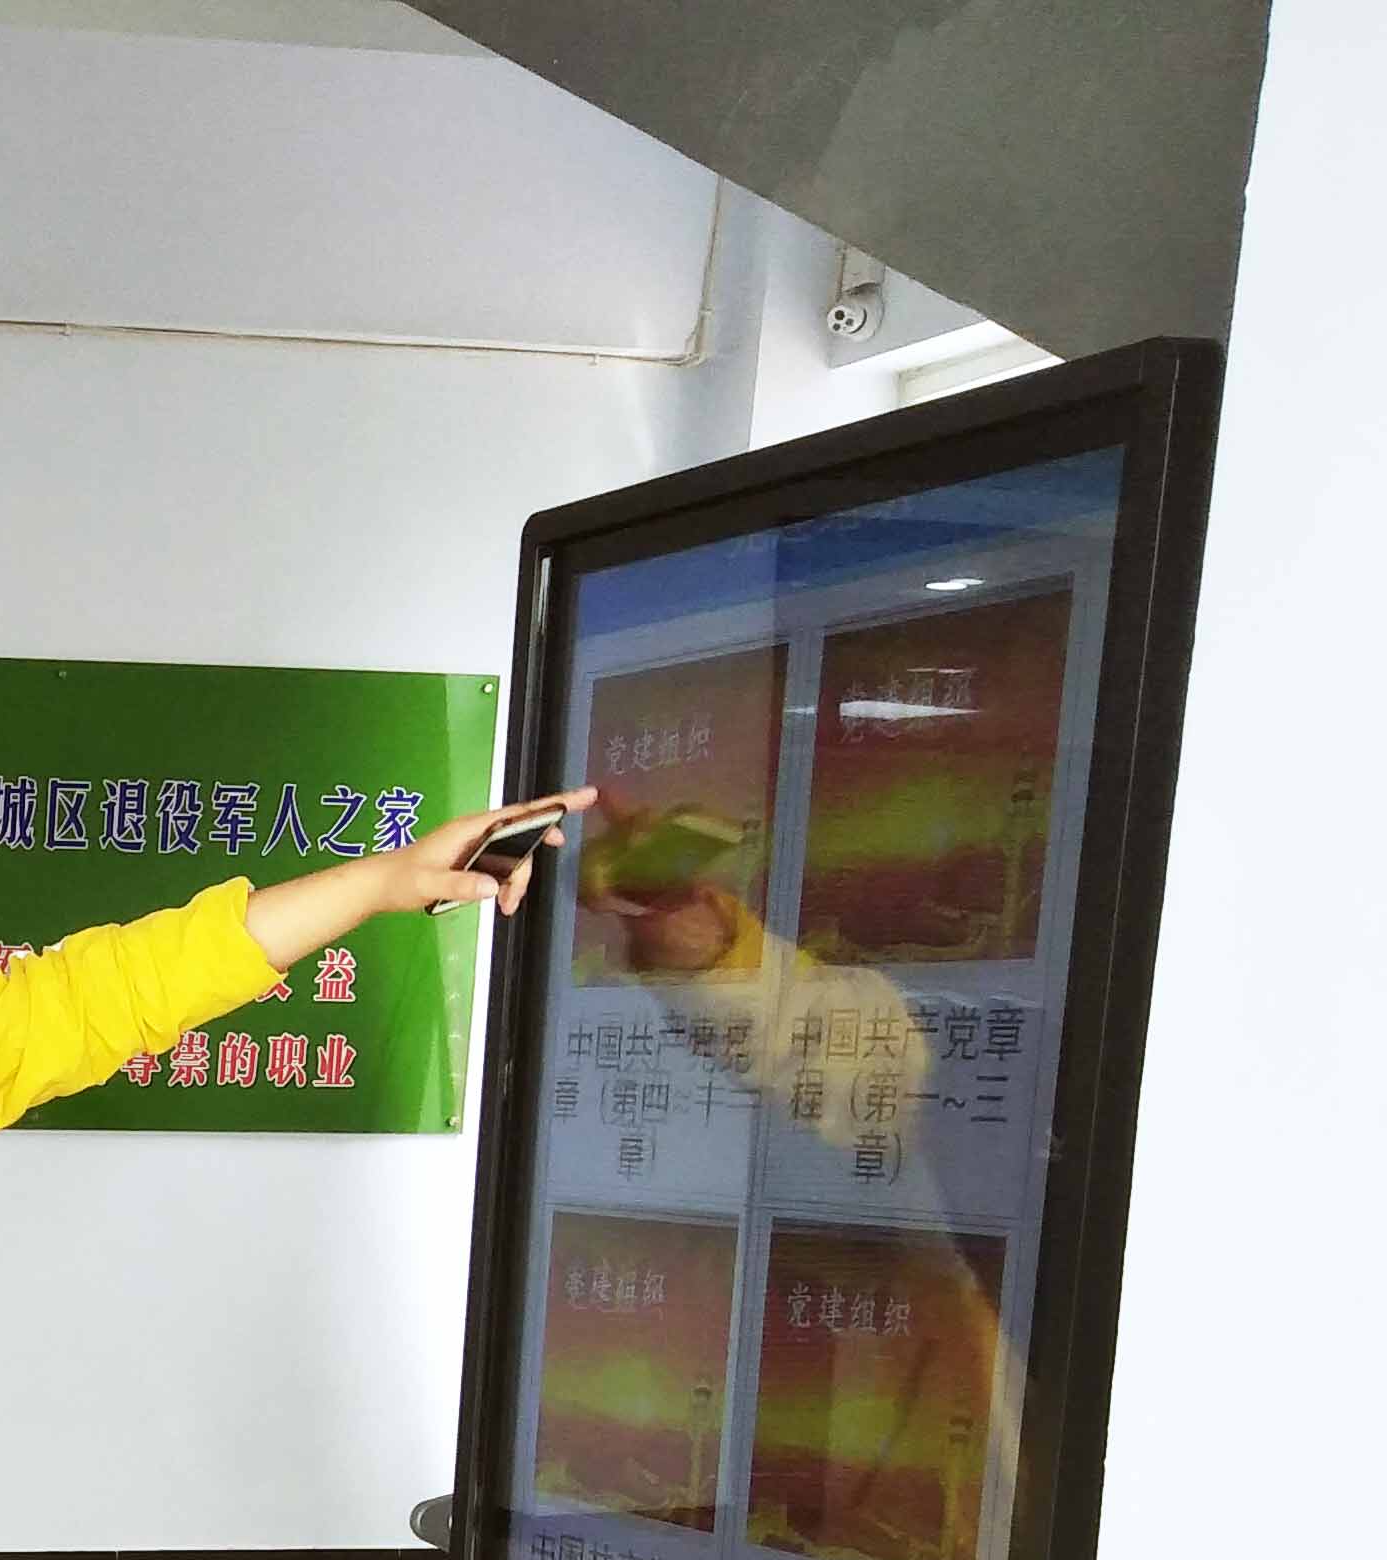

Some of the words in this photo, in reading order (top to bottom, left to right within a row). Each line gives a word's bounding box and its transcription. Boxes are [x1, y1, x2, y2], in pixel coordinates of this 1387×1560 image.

[603, 718, 715, 776] 党建组织
[791, 1004, 1025, 1062] 中国共产党章
[786, 1281, 912, 1337] 党建组织
